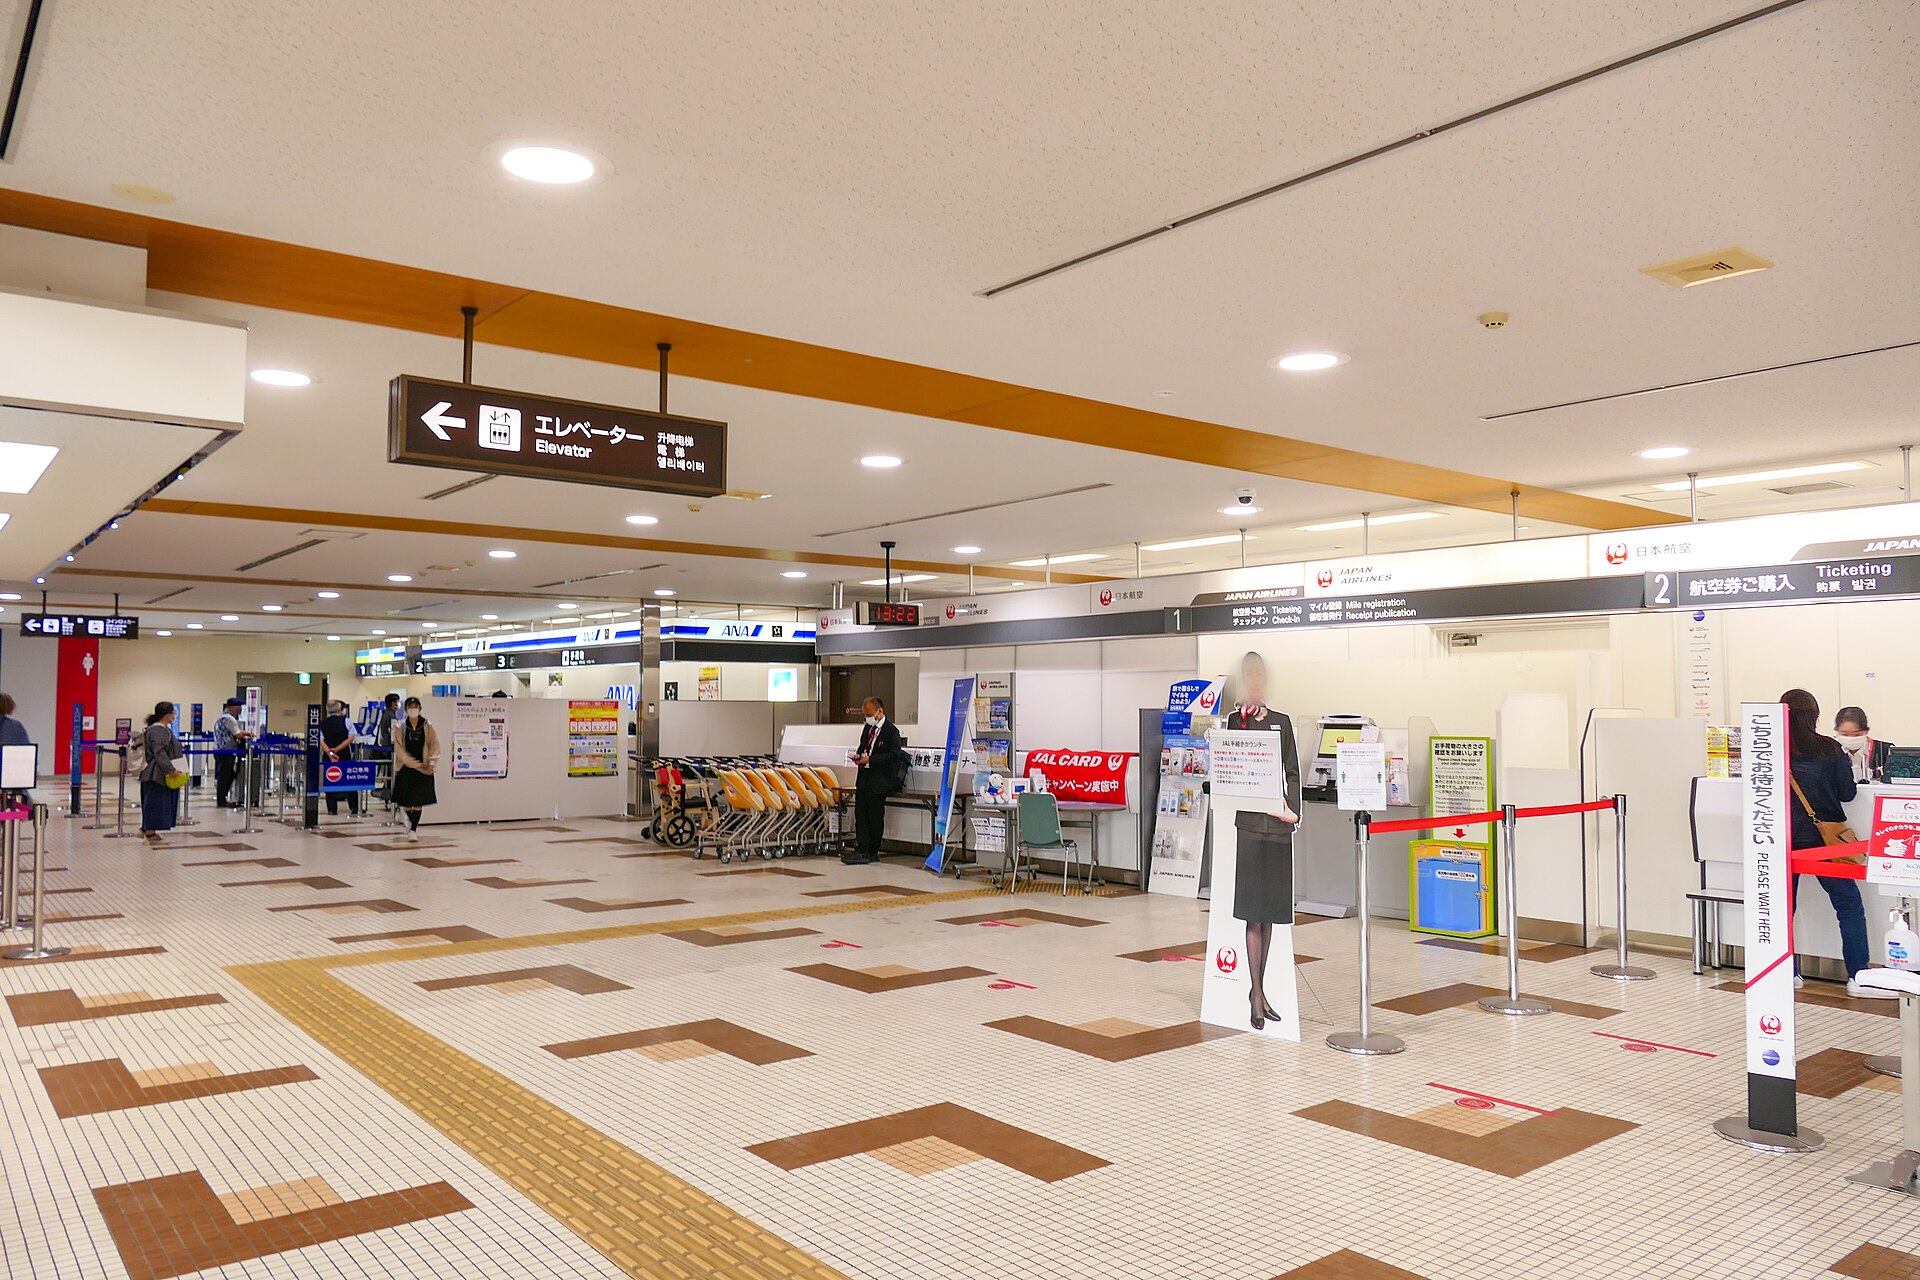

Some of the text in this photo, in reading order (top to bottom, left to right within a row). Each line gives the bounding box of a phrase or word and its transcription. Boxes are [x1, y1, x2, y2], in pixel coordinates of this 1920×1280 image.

[534, 415, 645, 444] エレベーター
[657, 432, 694, 447] 升降电梯
[535, 438, 592, 458] Elevator
[657, 456, 704, 473] 엘리베이터
[1636, 542, 1692, 557] 日本航空
[1863, 539, 1920, 553] JAPAN
[1339, 567, 1373, 575] JAPAN
[1816, 562, 1892, 577] Ticketing
[1341, 574, 1392, 584] AIRLINES
[1689, 574, 1796, 597] 航空券ご購入
[1224, 588, 1298, 601] JAPAN AIRLINES
[1654, 573, 1671, 604] 2
[1115, 591, 1143, 600] 日本航空
[1272, 605, 1302, 615] Ticketing
[1309, 600, 1342, 611] マイル登録
[1346, 598, 1406, 610] Mile registration
[877, 605, 916, 622] 13:22
[1173, 609, 1180, 630] 1
[1272, 615, 1301, 624] Check-in
[1346, 608, 1416, 621] Receipt publication
[1232, 616, 1269, 626] チェックイン
[722, 625, 749, 637] ANA
[415, 661, 424, 673] 2
[497, 655, 506, 667] 3
[360, 665, 366, 676] 1
[309, 728, 320, 748] EXIT
[1751, 714, 1775, 944] こちらでお待ちください PLEASE WAIT HERE
